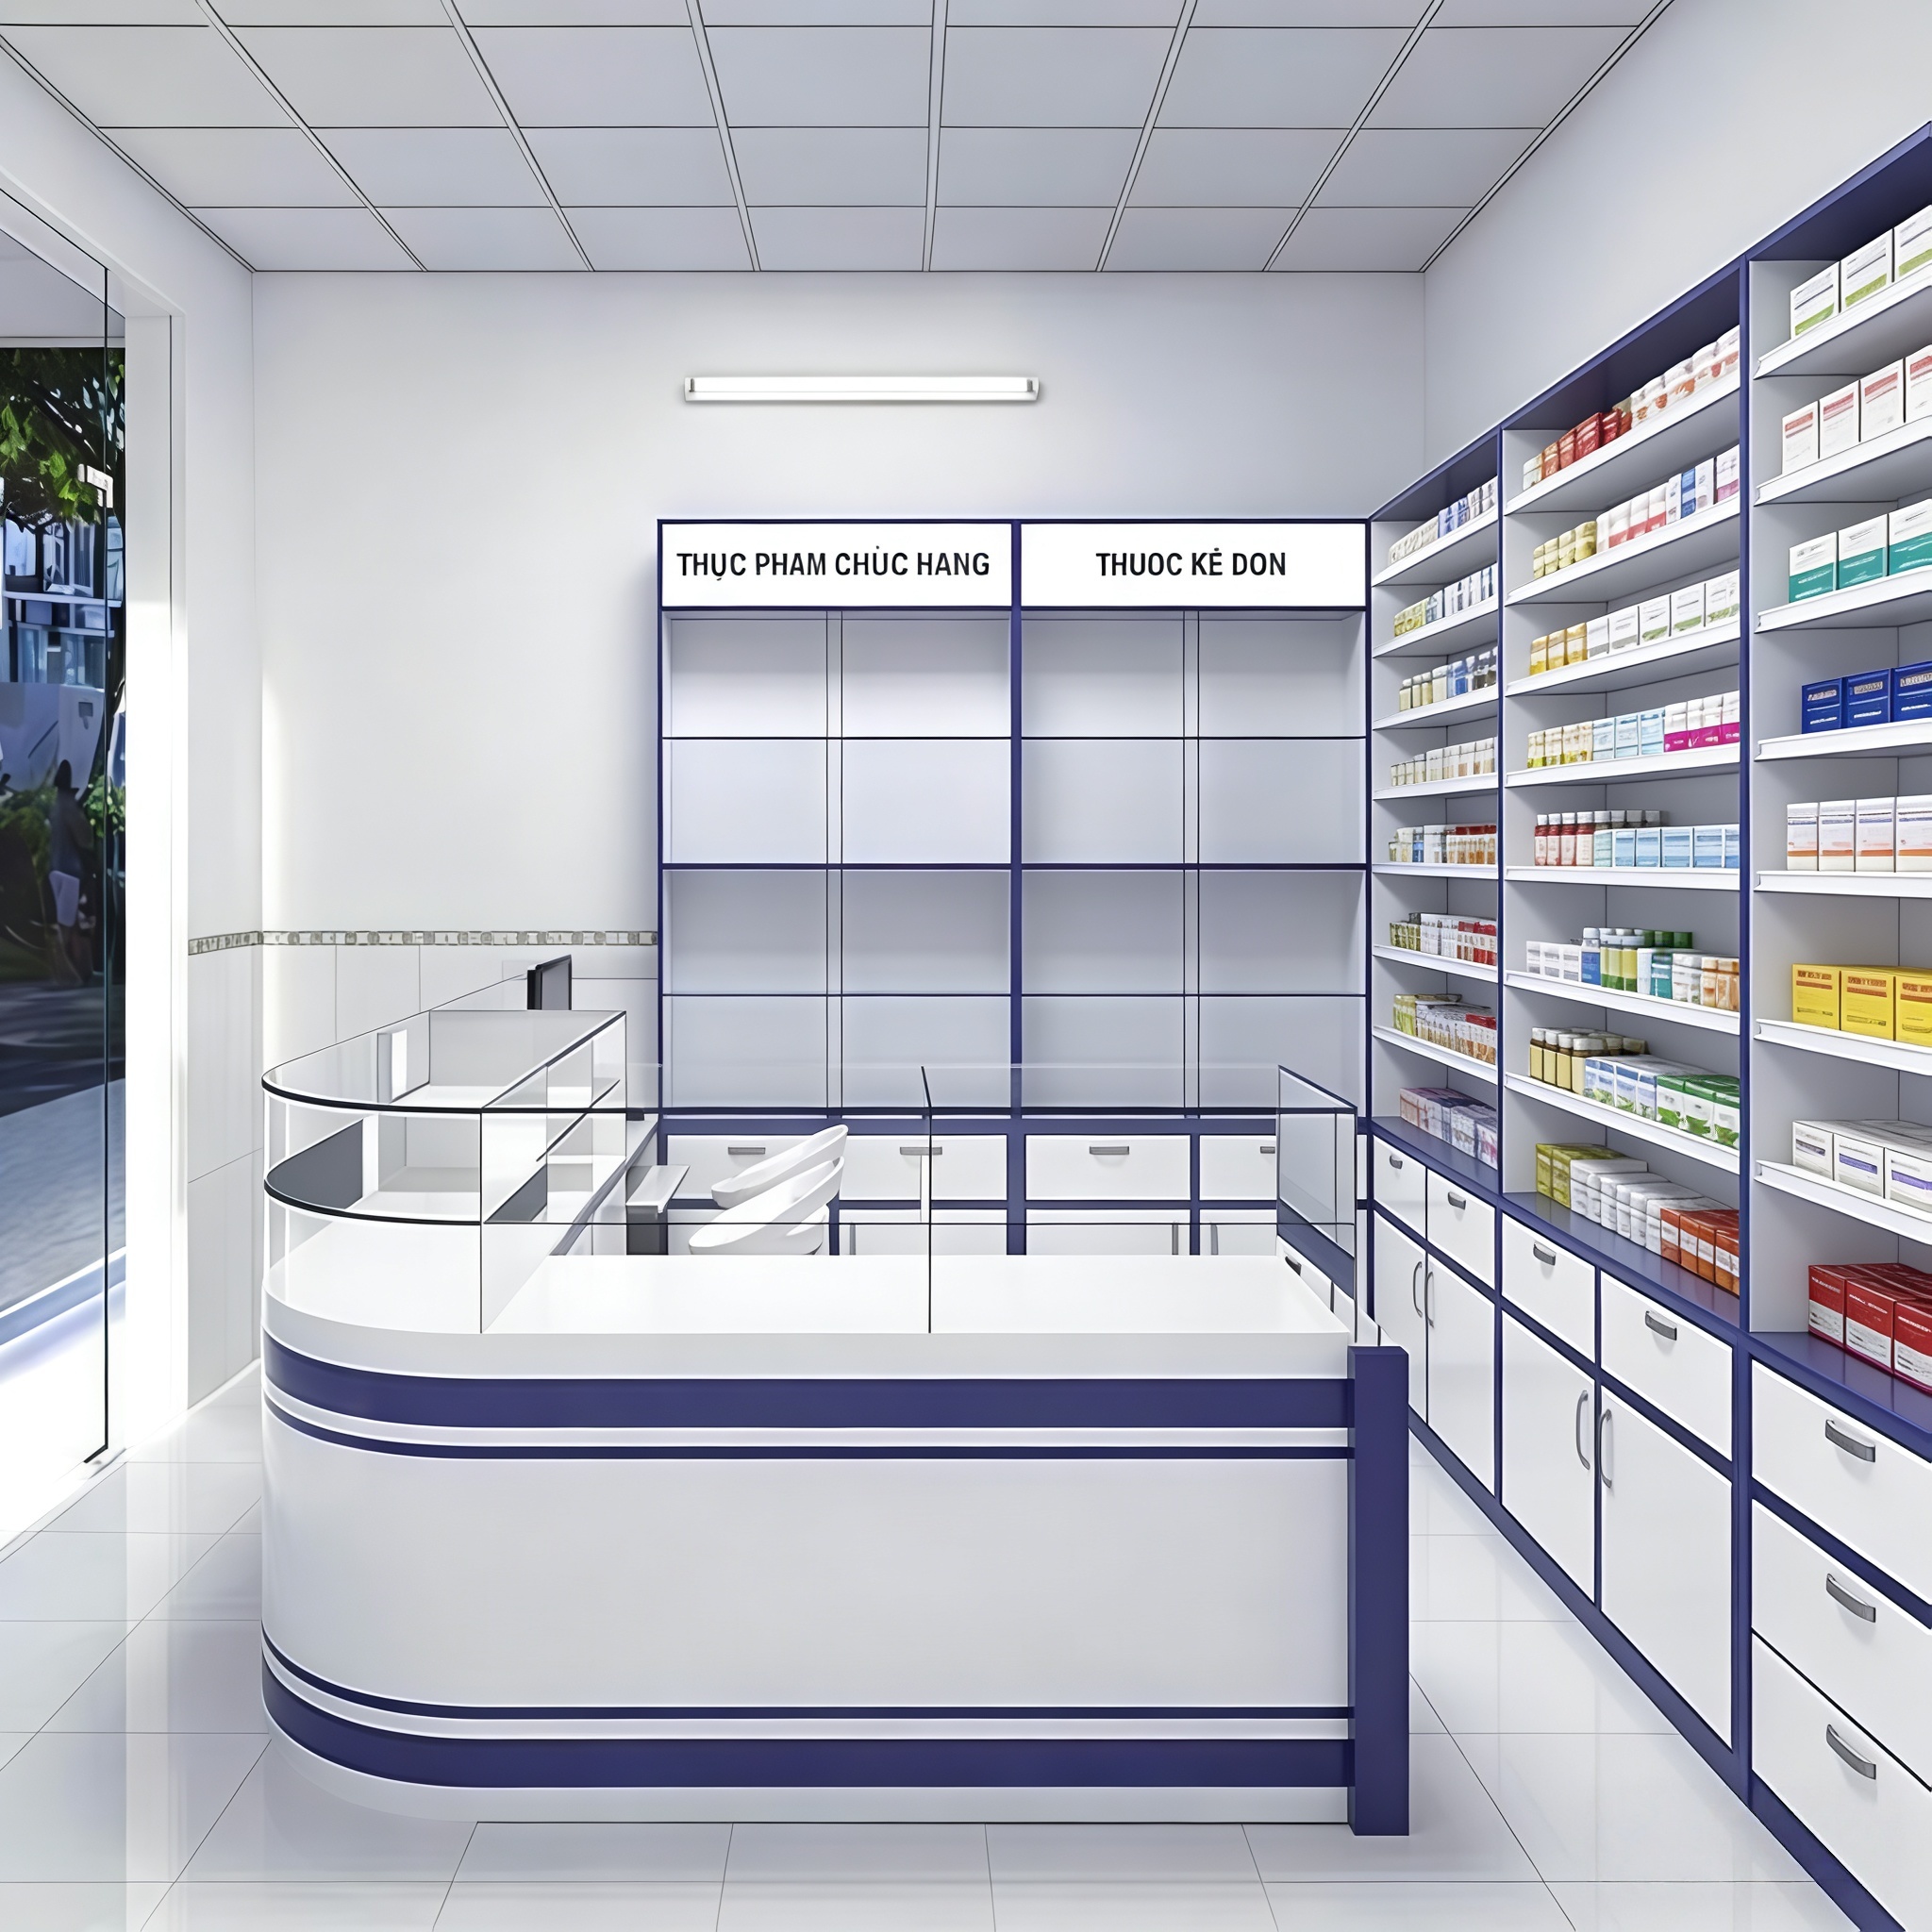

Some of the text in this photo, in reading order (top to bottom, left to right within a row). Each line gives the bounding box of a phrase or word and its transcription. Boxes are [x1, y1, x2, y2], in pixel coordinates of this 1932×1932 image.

[755, 552, 826, 576] PHAM
[917, 552, 990, 576] HANG
[1095, 552, 1183, 576] THUOC
[1232, 552, 1286, 576] DON
